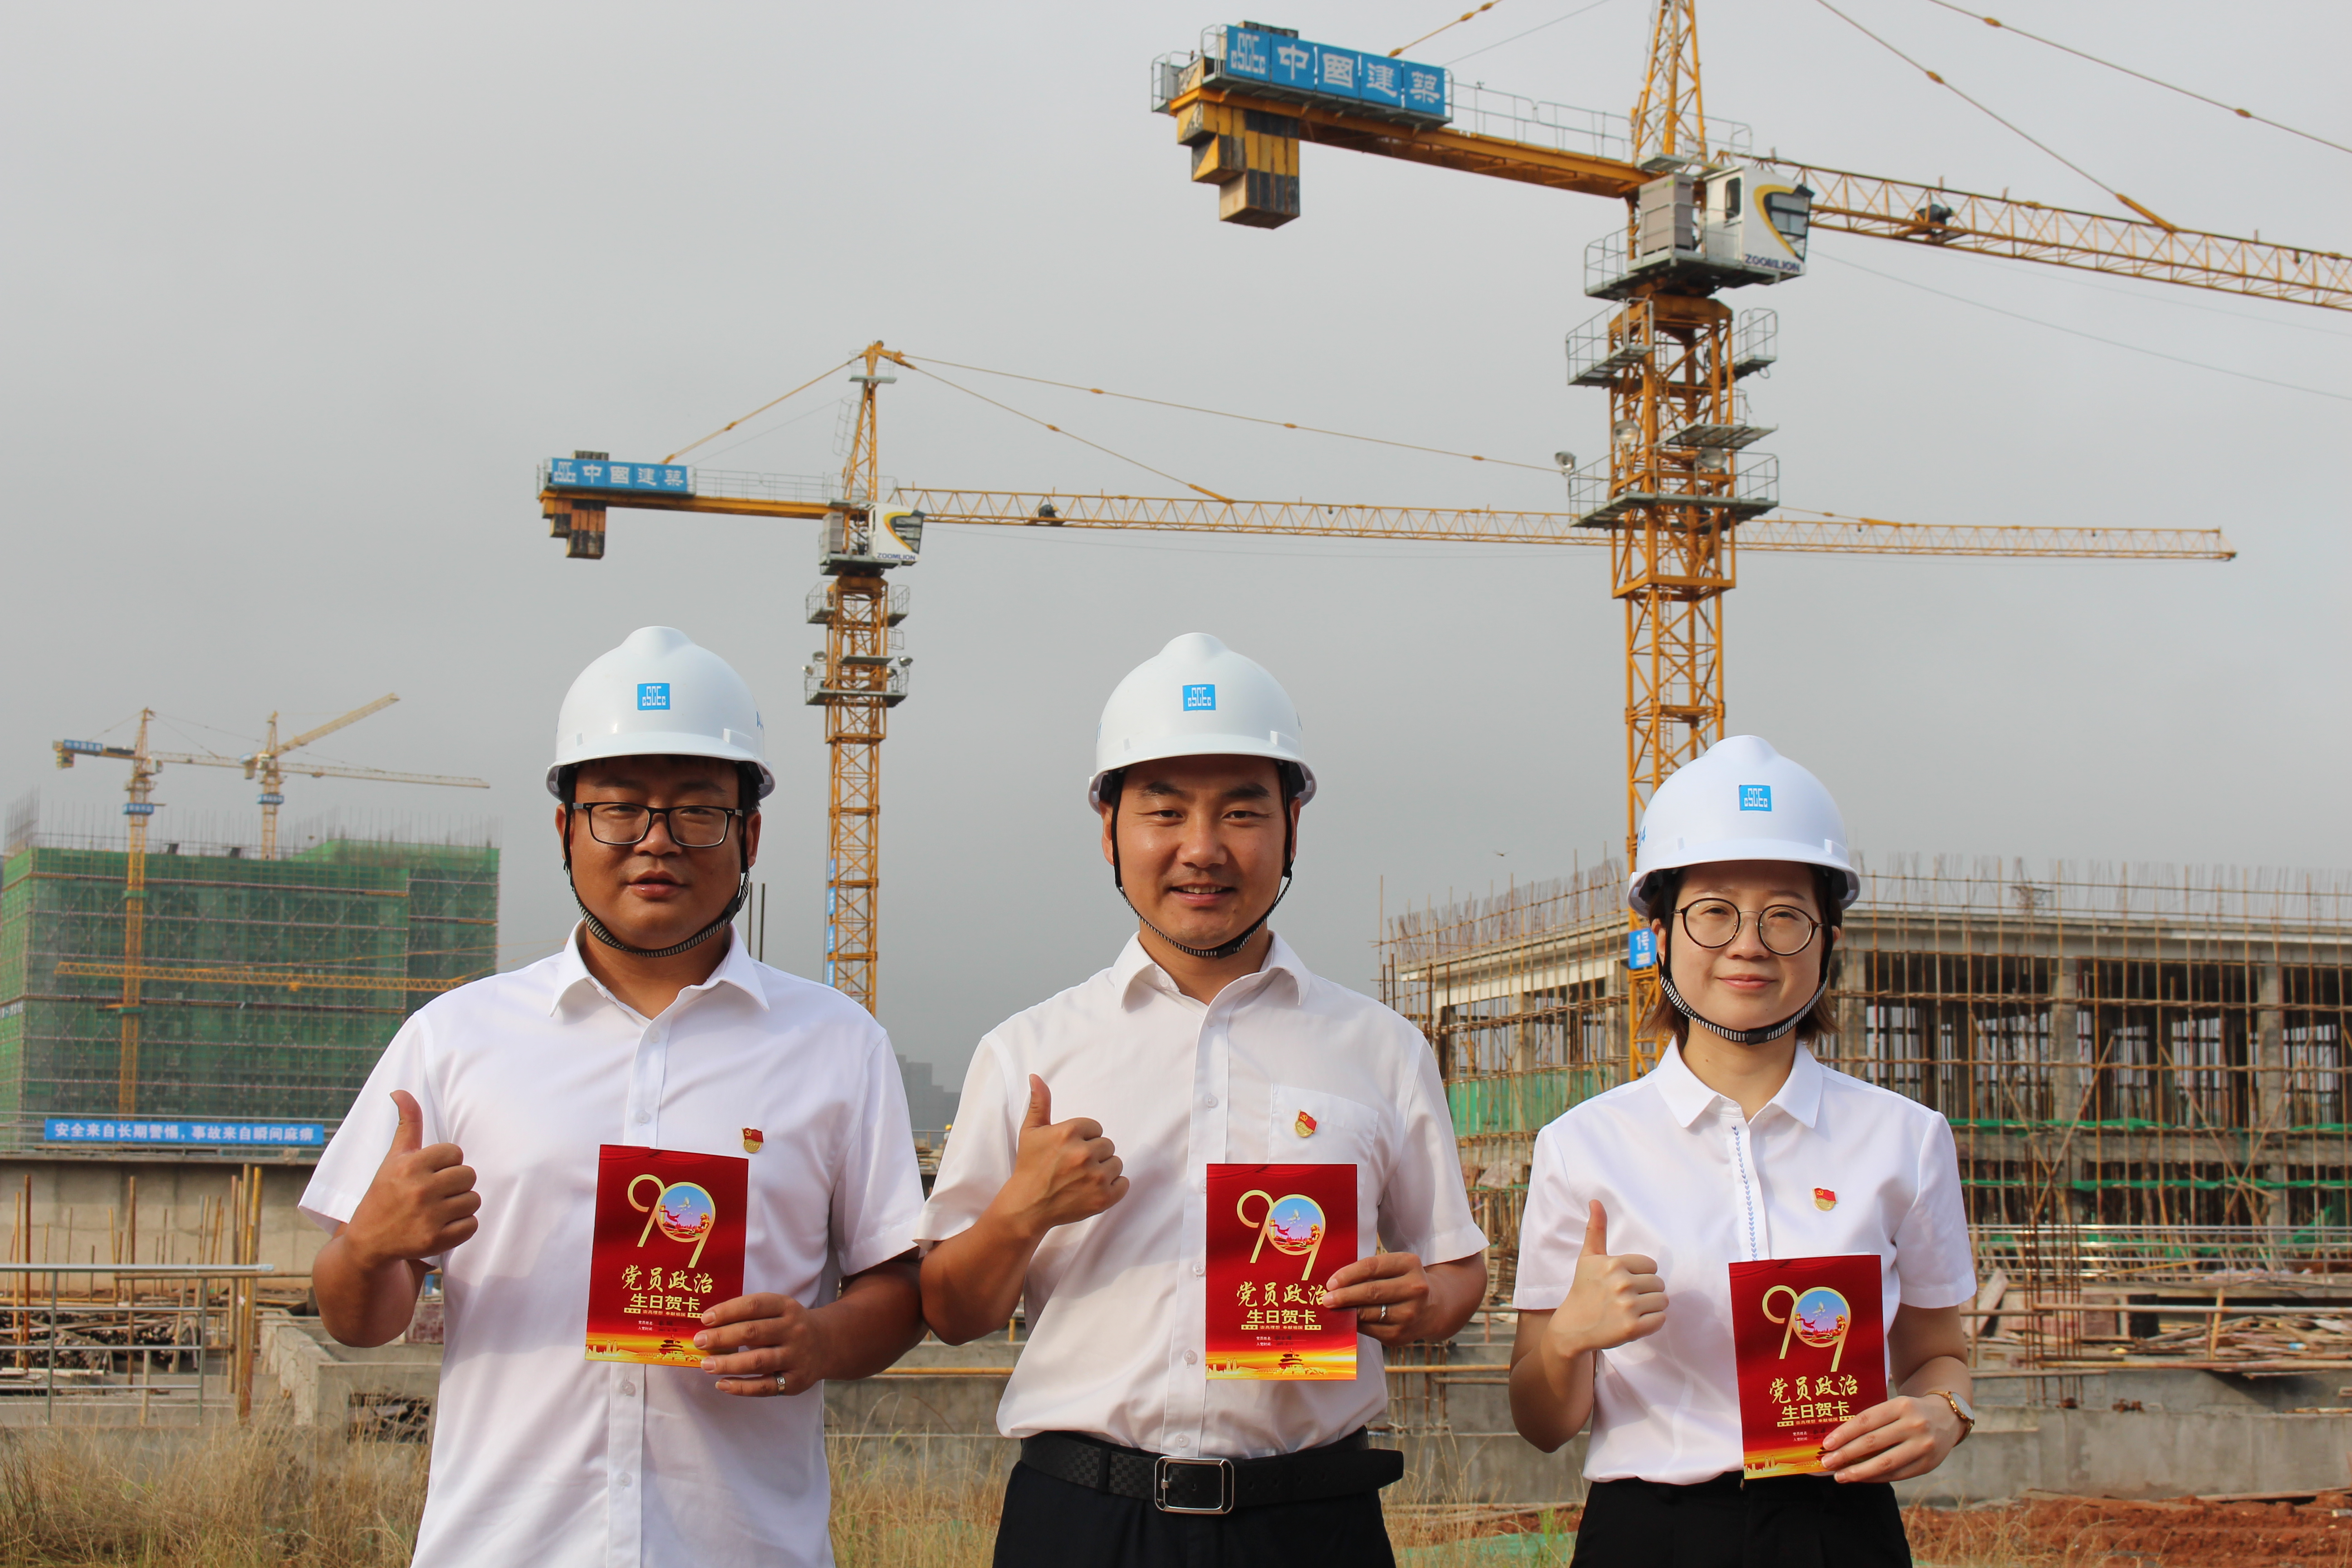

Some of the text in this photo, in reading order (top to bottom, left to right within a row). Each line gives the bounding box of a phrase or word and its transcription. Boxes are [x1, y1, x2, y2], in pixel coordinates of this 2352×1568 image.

[1277, 44, 1441, 104] 中國建築
[1745, 254, 1801, 273] ZOOMLION
[582, 464, 684, 487] 中國建築
[877, 553, 916, 561] ZOOMLION
[627, 1174, 716, 1269] 99
[1236, 1190, 1326, 1280] 99
[622, 1264, 713, 1294] 党员政治
[630, 1293, 700, 1311] 生日贺卡
[1236, 1281, 1328, 1307] 党员政治
[1246, 1309, 1316, 1324] 生日贺卡
[1762, 1285, 1851, 1372] 99
[1769, 1374, 1858, 1404] 党员政治
[1781, 1400, 1850, 1421] 生日贺卡
